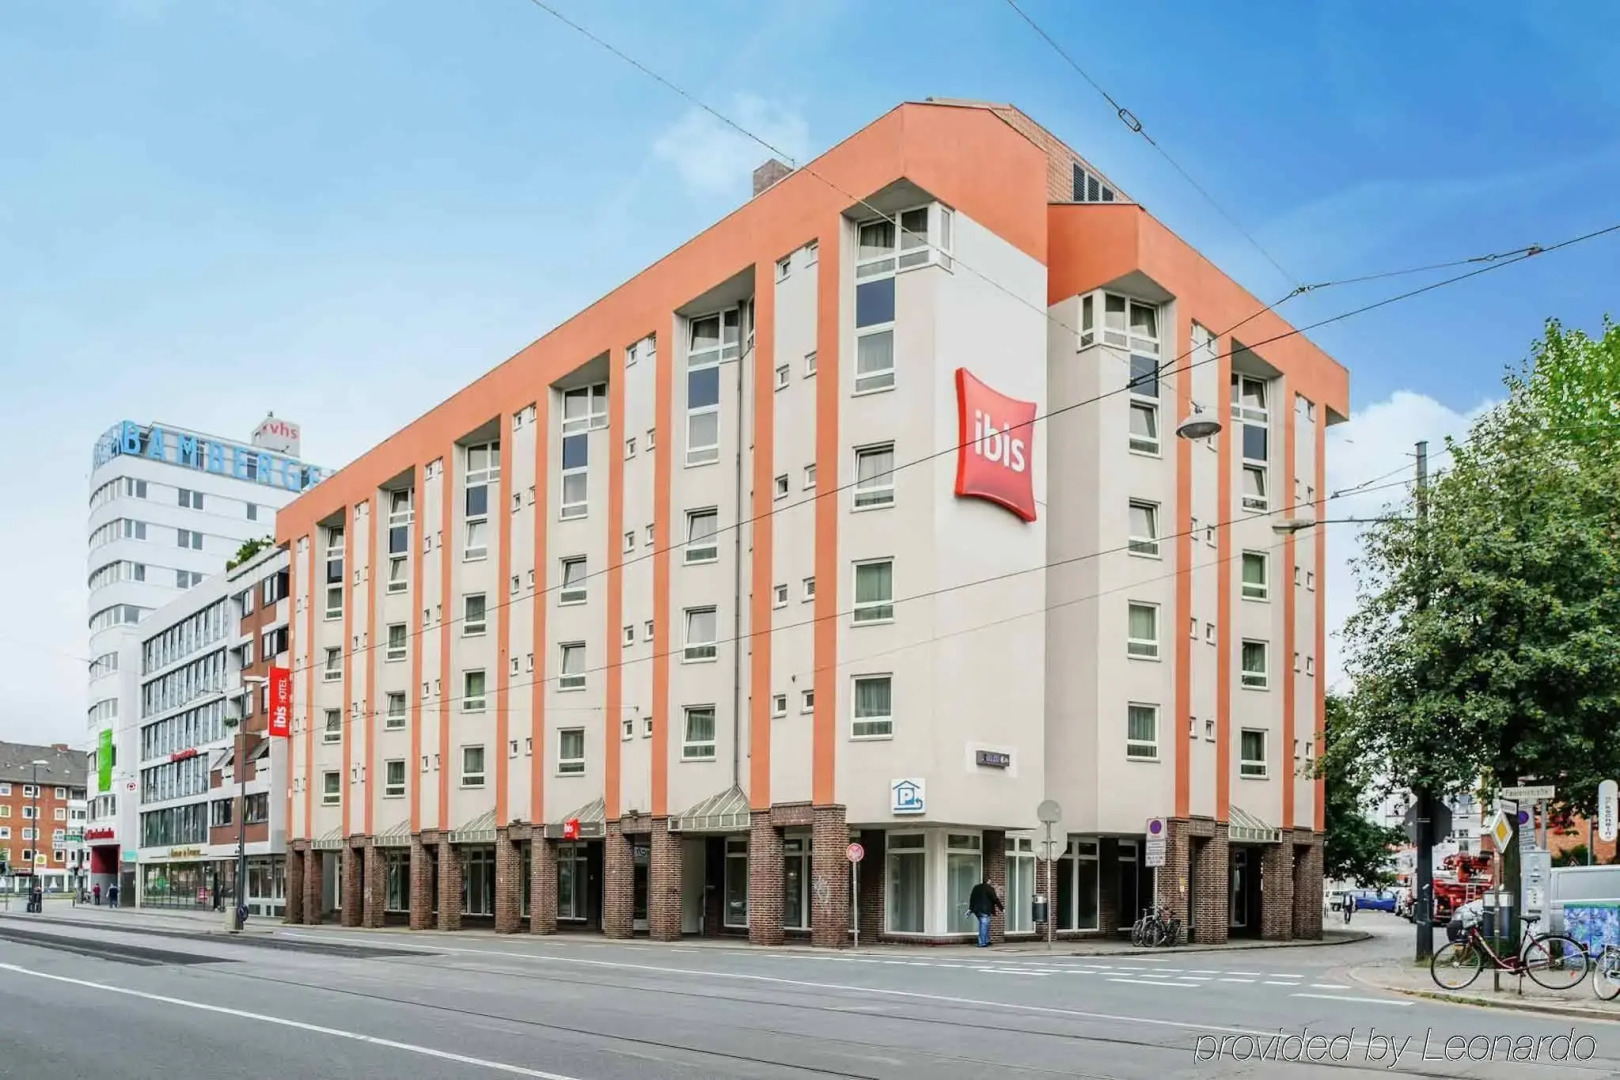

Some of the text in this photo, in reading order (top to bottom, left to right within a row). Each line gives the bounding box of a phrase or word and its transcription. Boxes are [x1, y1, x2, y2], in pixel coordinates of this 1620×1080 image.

[122, 420, 328, 493] BAMBERGE
[270, 421, 298, 439] vhs
[975, 409, 1025, 473] ibis
[273, 677, 287, 728] ibis HOTEL
